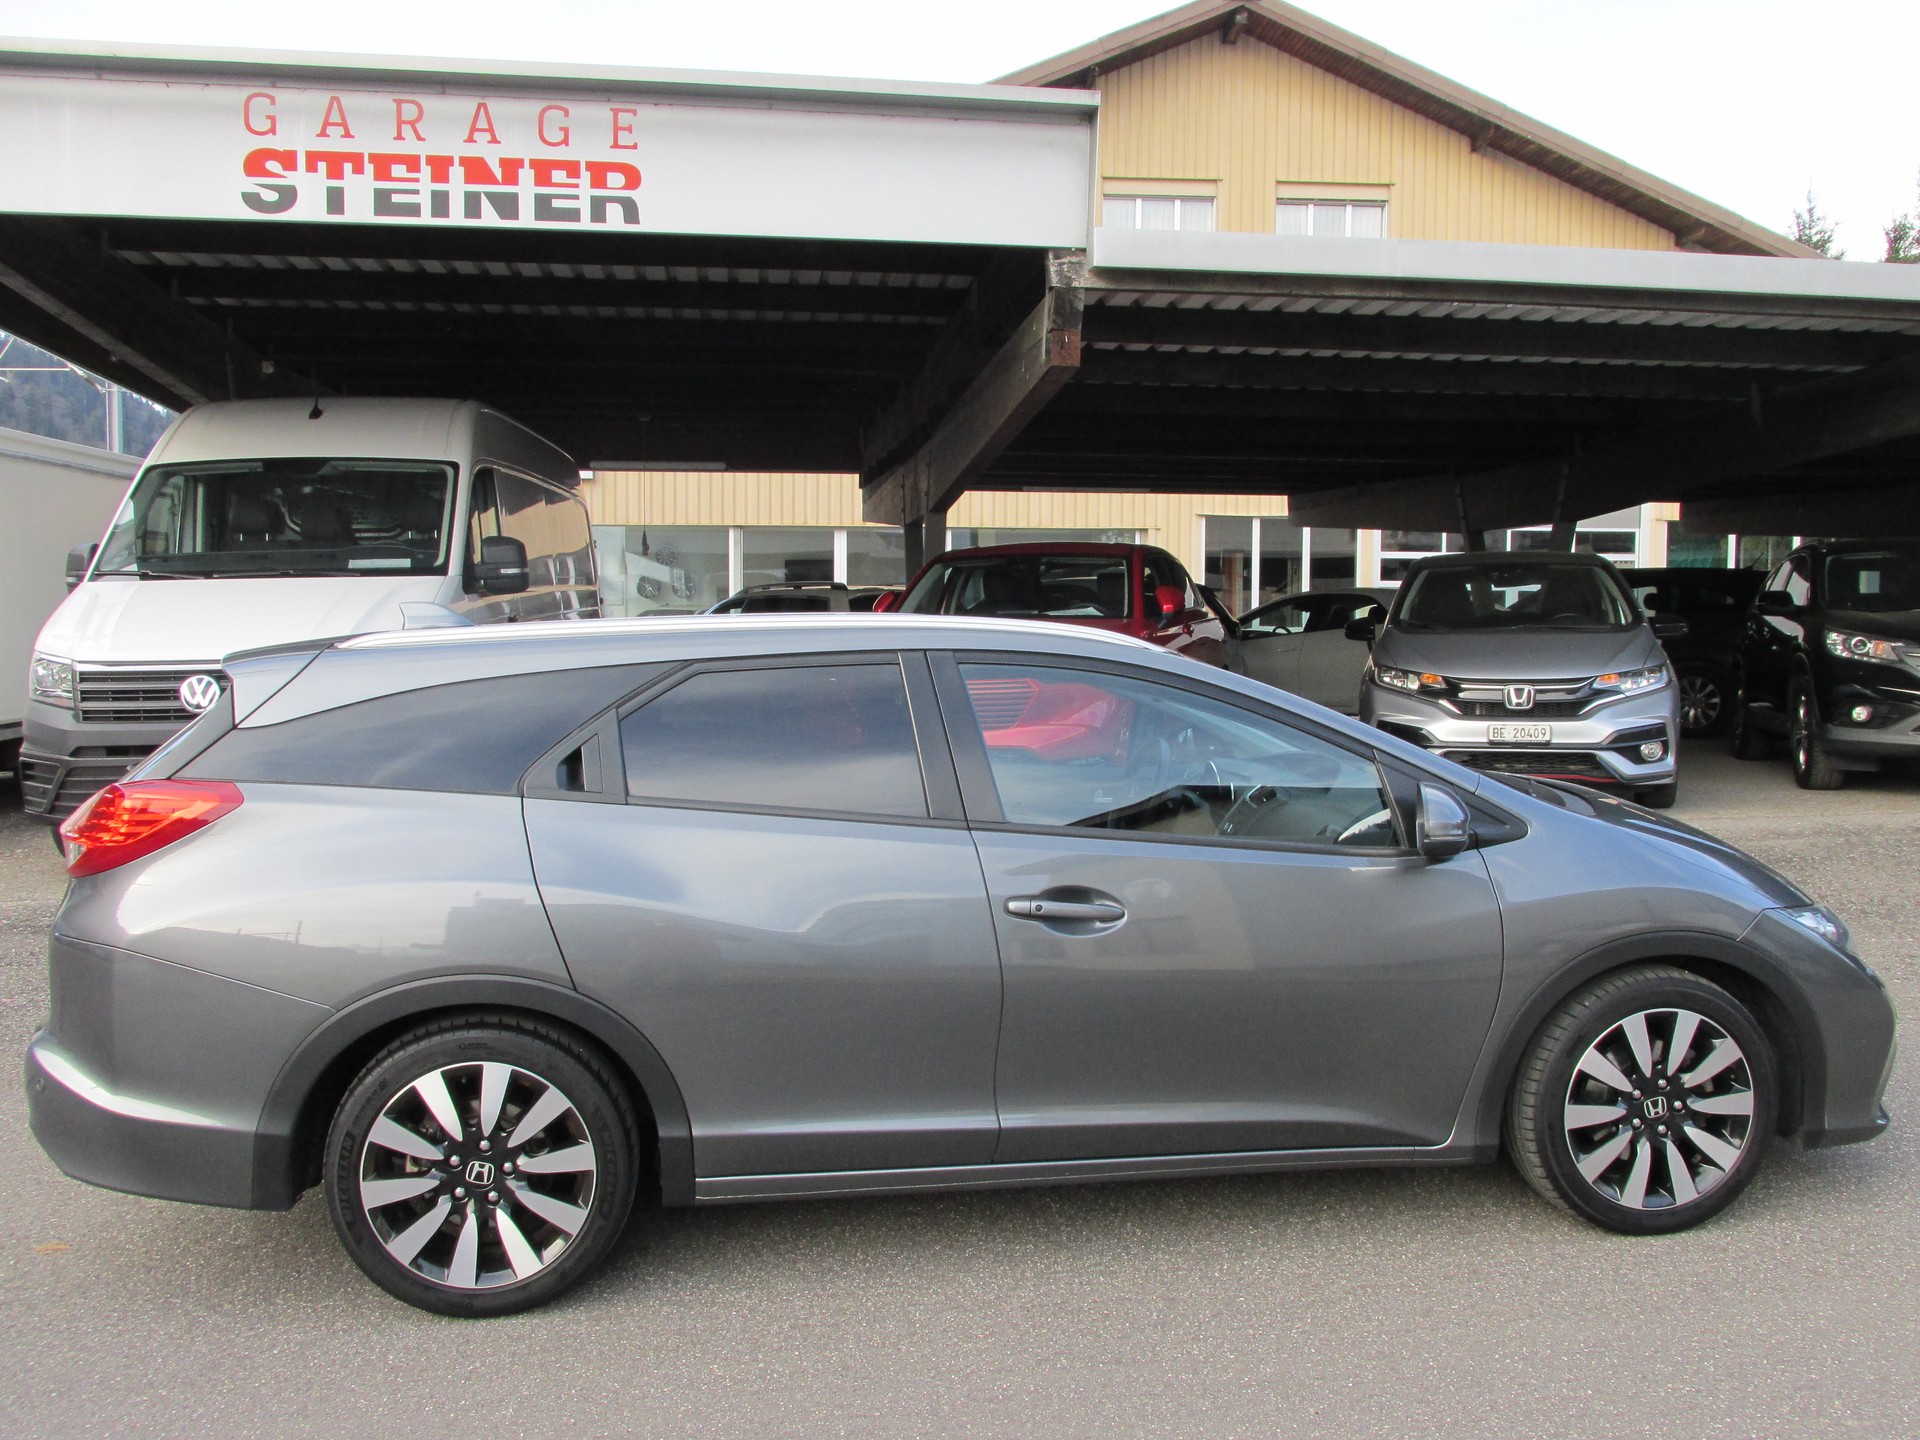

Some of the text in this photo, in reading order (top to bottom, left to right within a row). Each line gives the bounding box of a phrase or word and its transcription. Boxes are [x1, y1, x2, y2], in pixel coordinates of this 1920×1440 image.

[243, 92, 638, 150] GARAGE
[241, 147, 642, 225] STEINER
[1492, 727, 1547, 739] BE 20409
